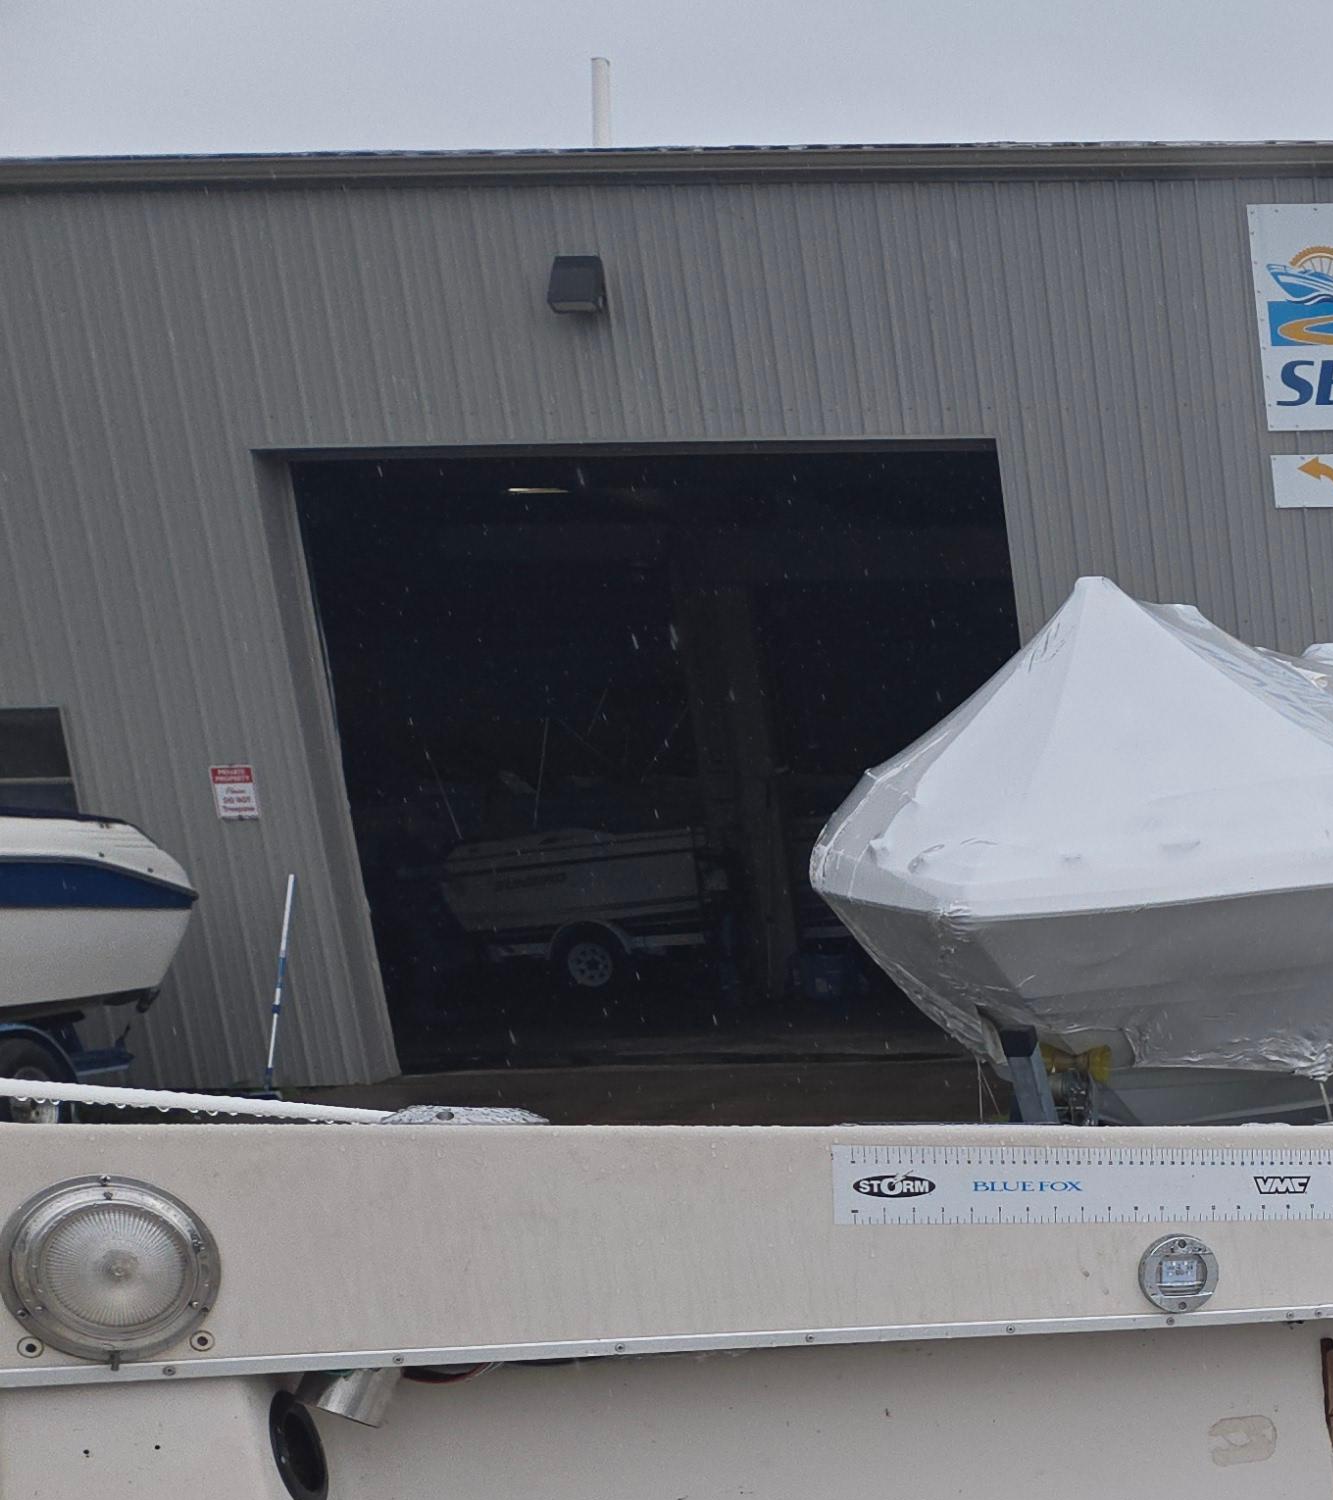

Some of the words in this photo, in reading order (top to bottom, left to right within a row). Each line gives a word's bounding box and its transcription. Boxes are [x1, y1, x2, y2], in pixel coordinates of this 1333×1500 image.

[859, 1173, 929, 1196] STORM
[972, 1180, 1035, 1192] BLUE
[1039, 1180, 1083, 1192] FOX
[1253, 1175, 1310, 1194] VMC
